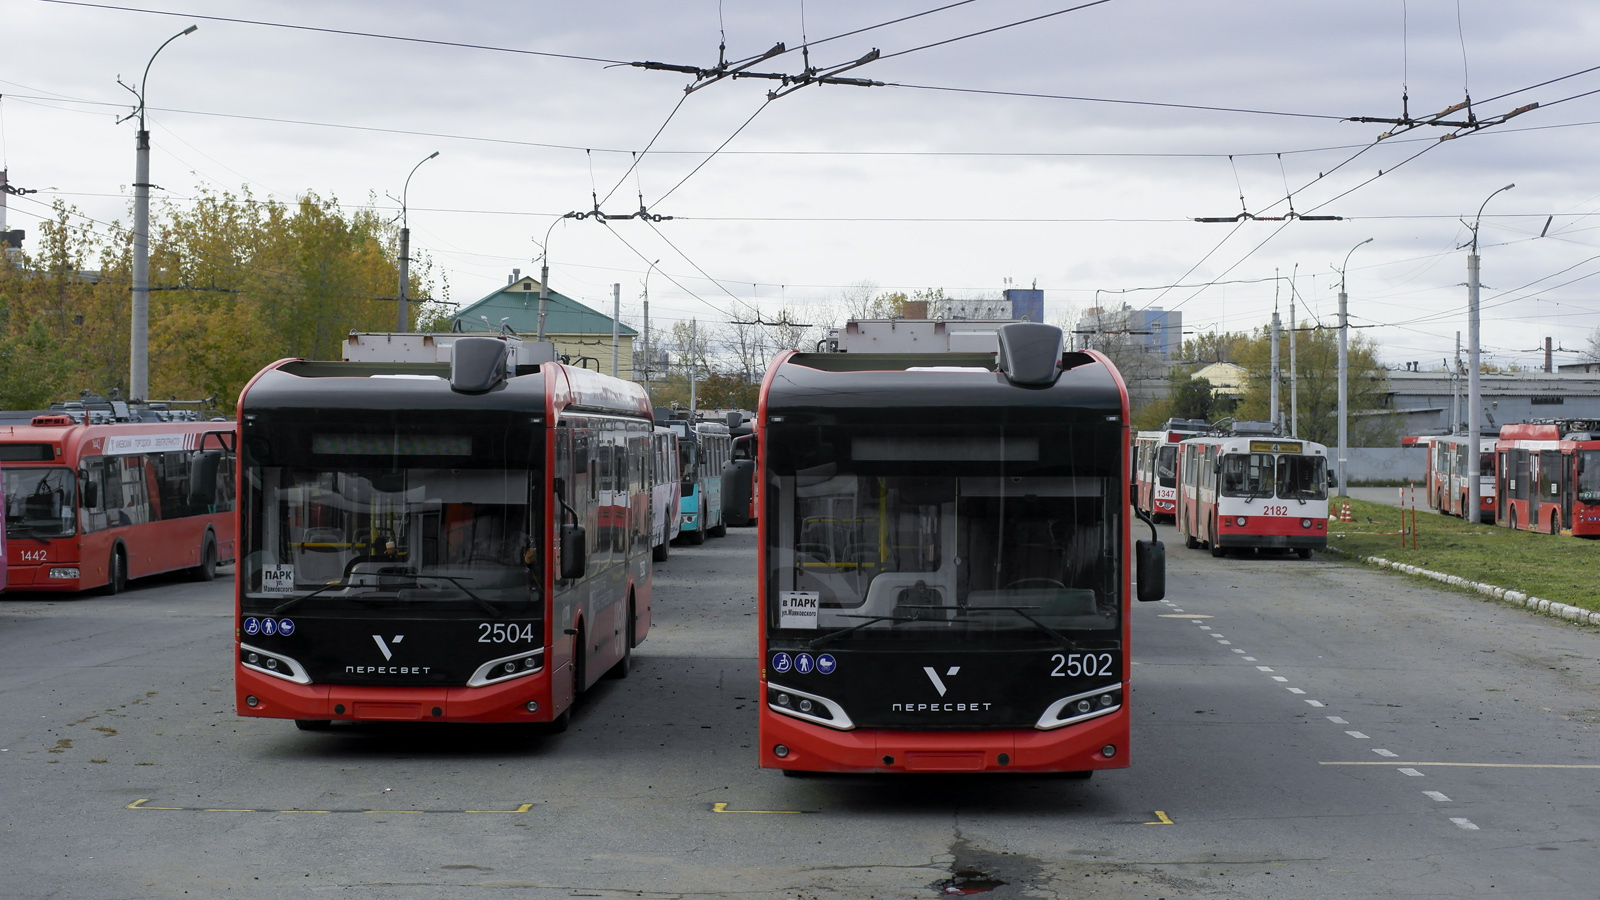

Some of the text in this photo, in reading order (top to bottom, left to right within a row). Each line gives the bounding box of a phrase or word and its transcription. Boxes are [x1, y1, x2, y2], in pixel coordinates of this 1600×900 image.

[1263, 506, 1288, 516] 2182
[20, 550, 47, 561] 1442
[265, 570, 292, 580] ПАРК
[263, 585, 293, 593] Маяковского
[790, 598, 817, 608] ПАРК
[478, 622, 534, 643] 2504
[345, 666, 431, 674] ПЕРЕСВЕТ
[1050, 653, 1113, 678] 2502
[892, 702, 992, 712] ПЕРЕСВЕТ
